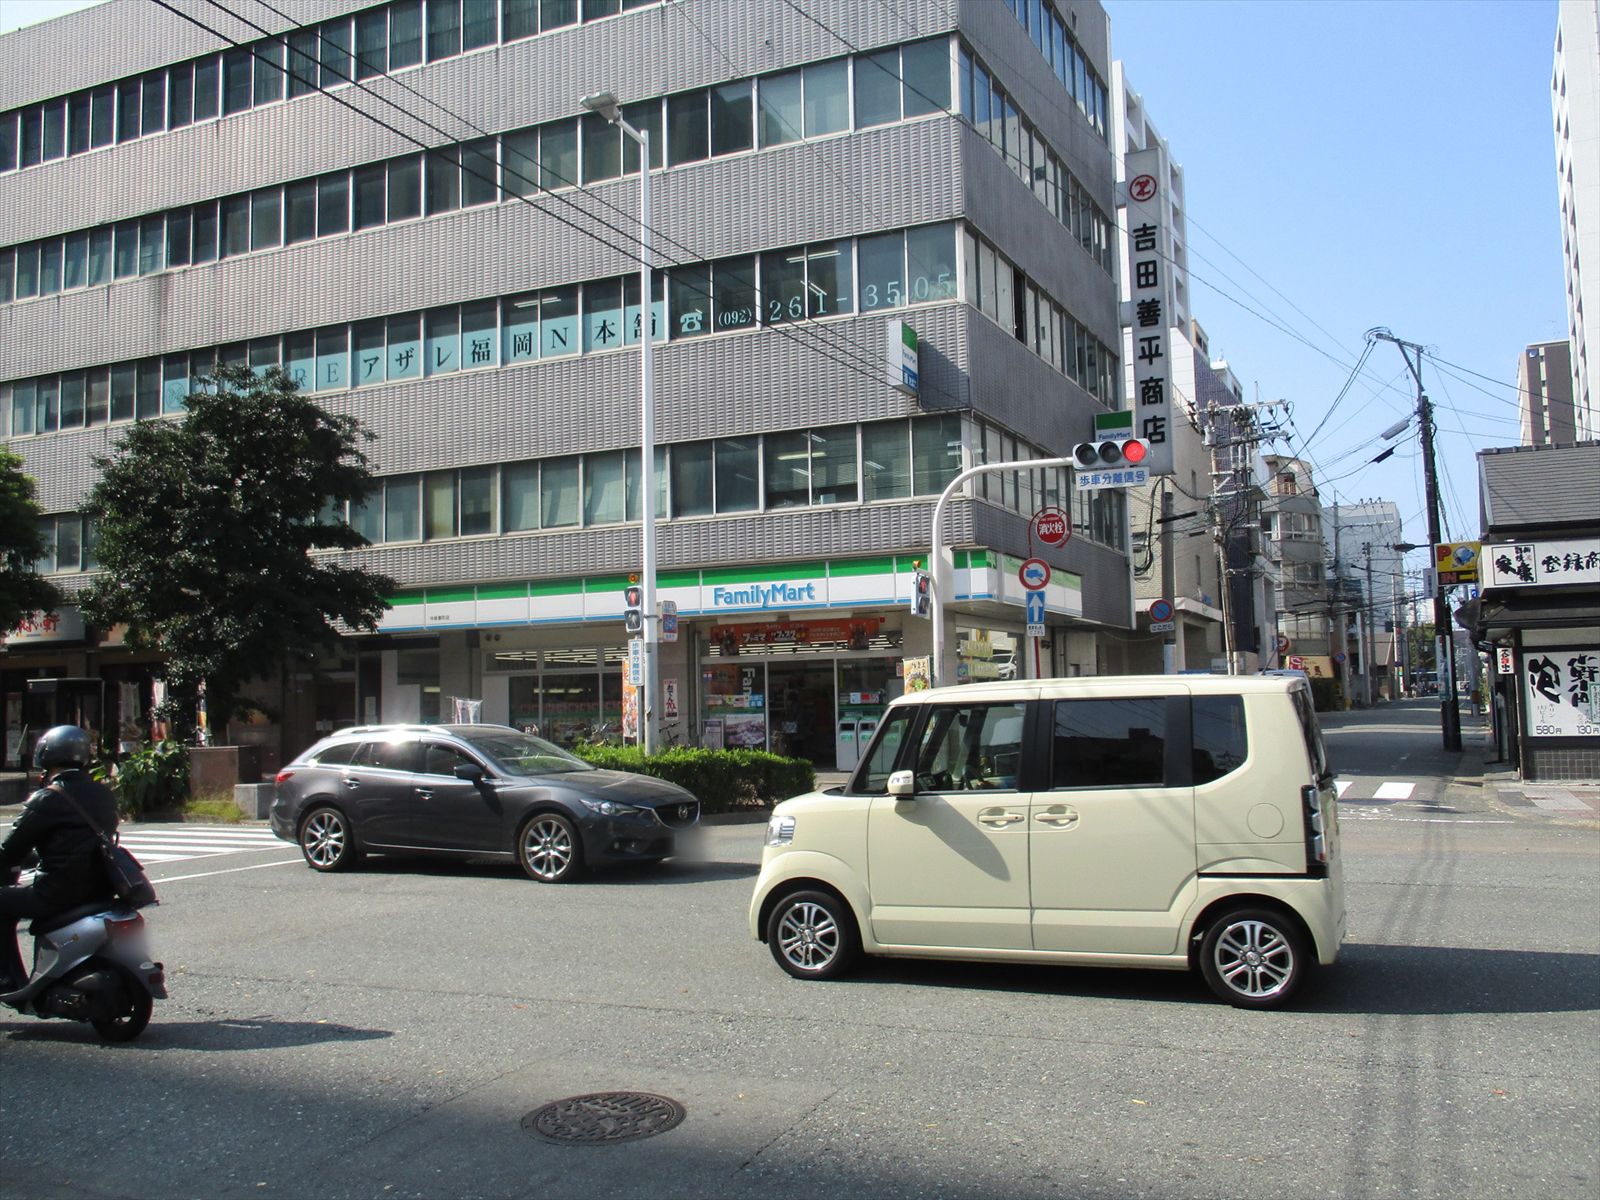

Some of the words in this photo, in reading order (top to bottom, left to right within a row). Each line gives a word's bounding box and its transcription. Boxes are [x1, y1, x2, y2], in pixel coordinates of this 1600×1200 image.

[1132, 222, 1165, 445] 吉田善平商店
[1098, 430, 1132, 440] FamilyMart
[1079, 470, 1146, 487] 歩車分離信号
[1038, 521, 1064, 535] 消火栓
[1437, 546, 1451, 561] P
[713, 582, 816, 607] FamilyMart
[1536, 725, 1562, 735] 580円
